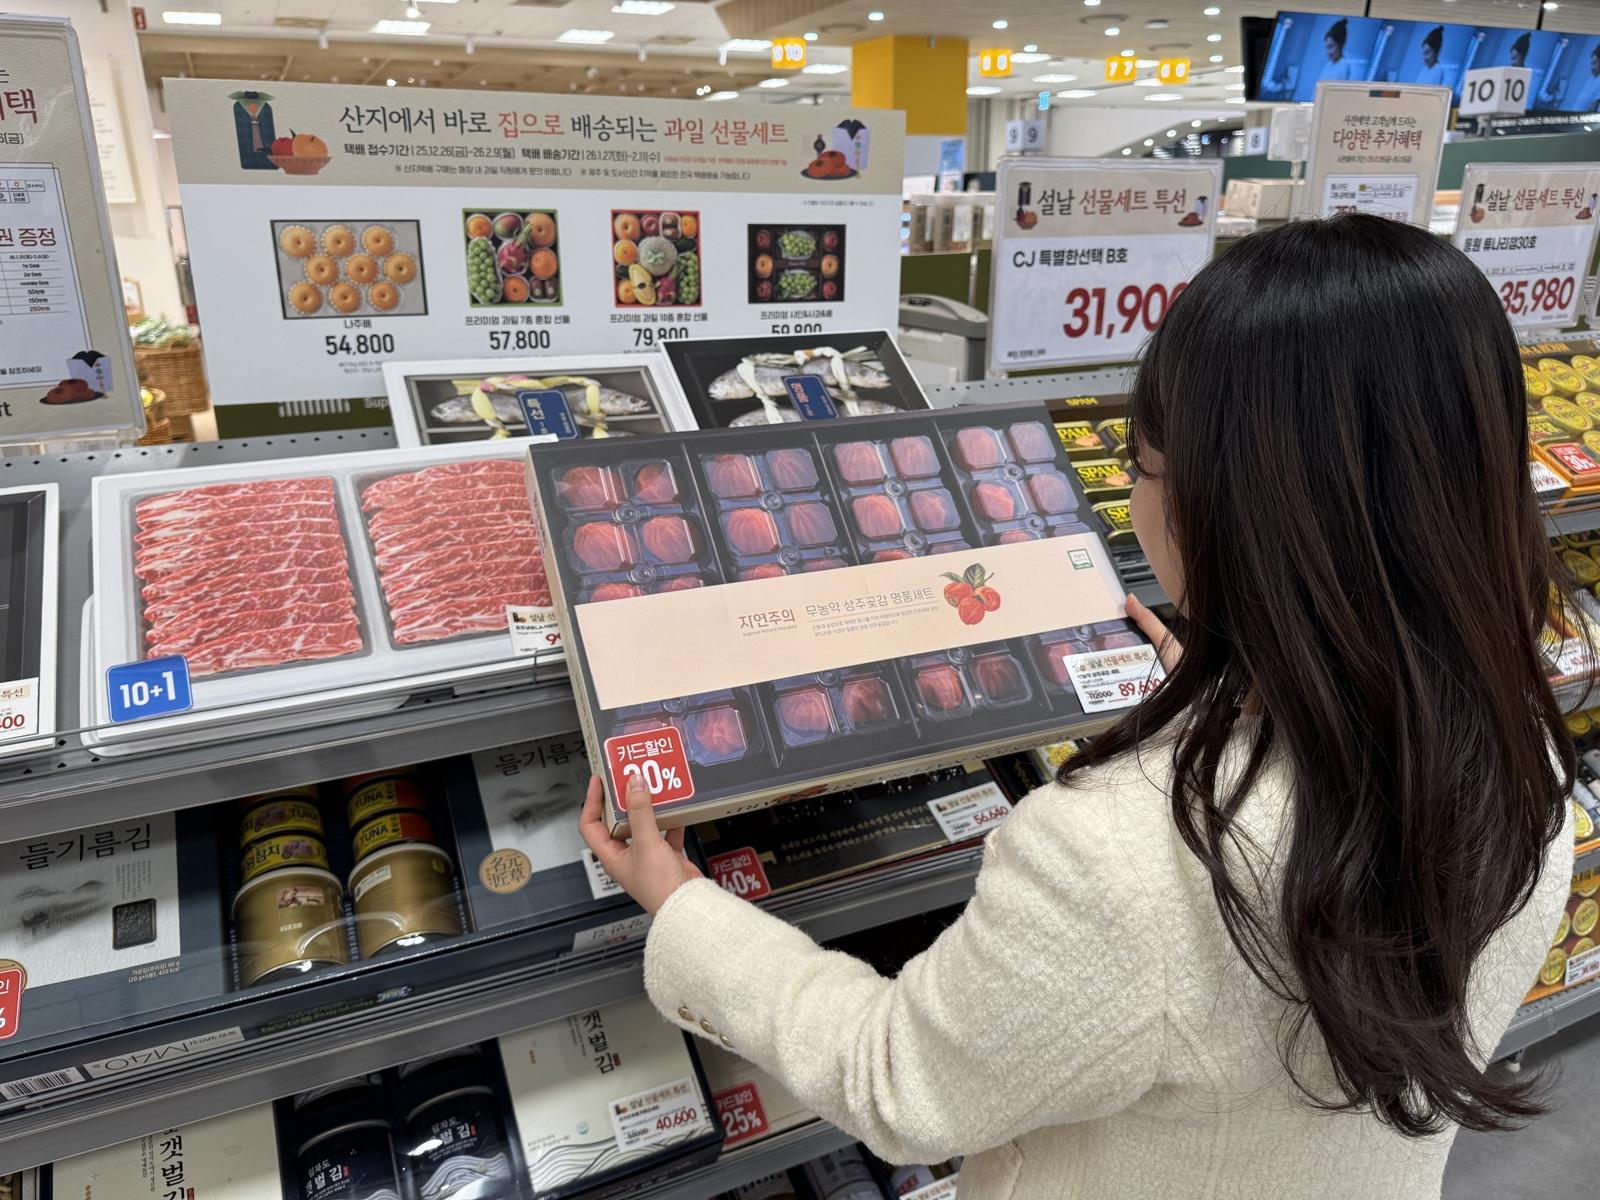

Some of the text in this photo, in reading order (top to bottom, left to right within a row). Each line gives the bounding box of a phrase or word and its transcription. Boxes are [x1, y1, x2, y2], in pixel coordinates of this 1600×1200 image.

[1468, 79, 1495, 103] 10
[1503, 78, 1525, 101] 10
[339, 105, 789, 146] 산지에서 바로 집으로 배송되는 과일 선물세트
[1028, 126, 1038, 142] 9
[1333, 129, 1422, 151] 다양한 추가혜택
[344, 143, 365, 156] 택배
[368, 143, 410, 157] 접수기간
[521, 148, 541, 160] 택배
[543, 148, 580, 161] 배송기간
[1038, 188, 1187, 216] 설날 선물세트 특선
[1486, 187, 1585, 212] 설날 선물세트 특선
[18, 228, 57, 247] 증정
[1013, 248, 1128, 267] CJ 특별한선택 B호
[1499, 276, 1574, 315] 35,980
[344, 319, 372, 329] 나주배
[465, 315, 571, 326] 프리미엄 과일 7종 혼합 선물
[609, 312, 642, 323] 프리미엄
[643, 312, 658, 323] 과일
[693, 311, 709, 322] 선물
[760, 310, 788, 321] 프리미엄
[325, 333, 395, 356] 54,800
[489, 329, 550, 351] 57,800
[632, 327, 689, 347] 79,800
[1065, 397, 1098, 407] SPAM
[1057, 427, 1091, 440] PAM
[1077, 465, 1121, 479] SPAM
[805, 587, 935, 618] 무농약 상주곶감 명품세트
[739, 608, 796, 630] 자연주의
[120, 671, 176, 709] 10+1
[0, 714, 25, 730] 00
[617, 737, 674, 761] 카드할인
[354, 791, 384, 807] TUNA
[360, 826, 388, 844] TUNA
[19, 823, 151, 870] 들기름김
[712, 855, 752, 874] 카드할인
[583, 1009, 615, 1075] 갯벌김
[656, 1108, 697, 1131] 40,600
[722, 1107, 762, 1137] 25%
